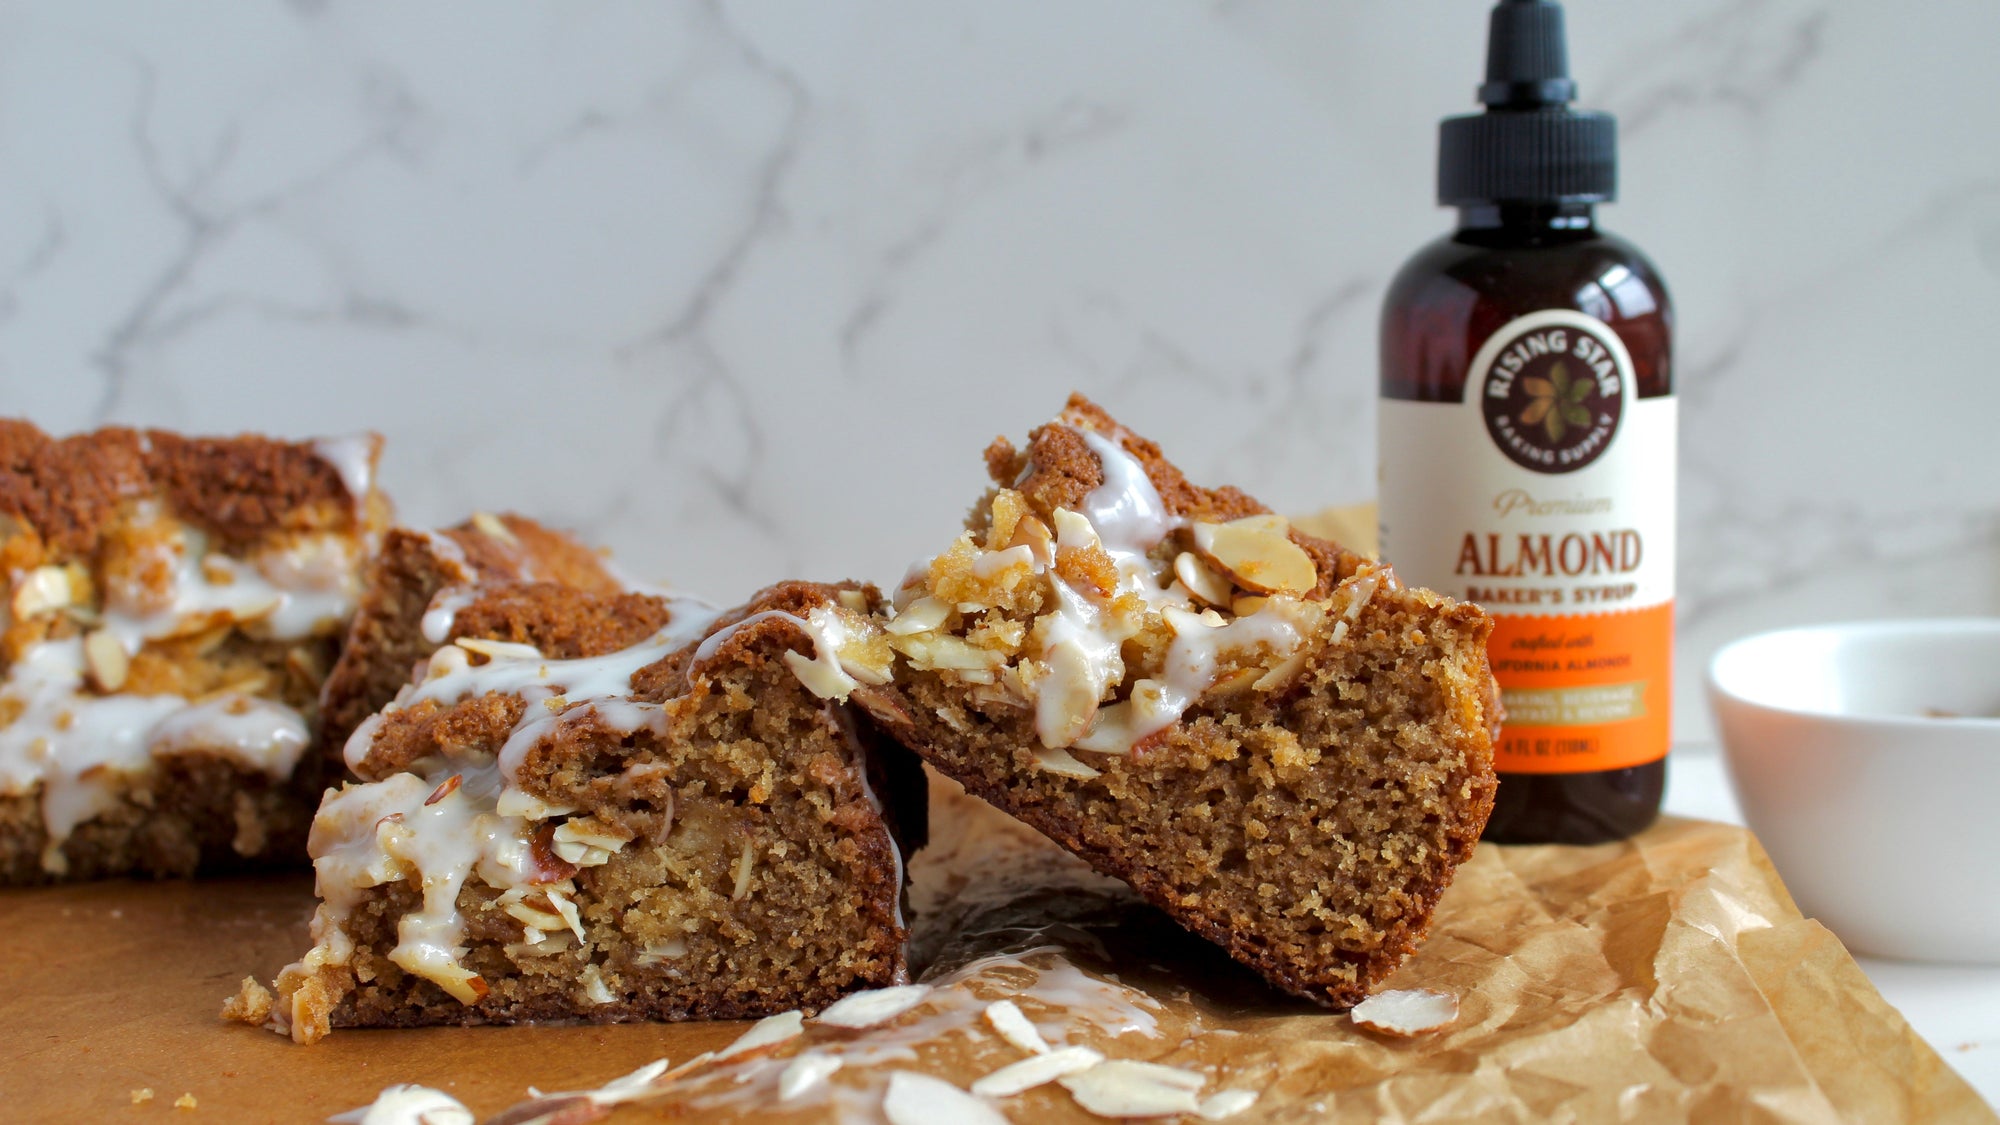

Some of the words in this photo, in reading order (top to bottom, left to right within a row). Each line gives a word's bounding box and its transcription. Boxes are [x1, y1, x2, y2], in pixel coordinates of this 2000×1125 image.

[1489, 330, 1567, 399] RISING
[1573, 336, 1620, 398] STAR
[1495, 414, 1554, 464] BAKING
[1560, 413, 1613, 464] SUPPLY
[1493, 488, 1613, 518] Premium
[1455, 530, 1643, 577] ALMOND
[1466, 585, 1563, 605] BAKER'S
[1573, 582, 1637, 603] SYRUP
[1516, 738, 1531, 756] FL
[1535, 738, 1551, 756] OZ
